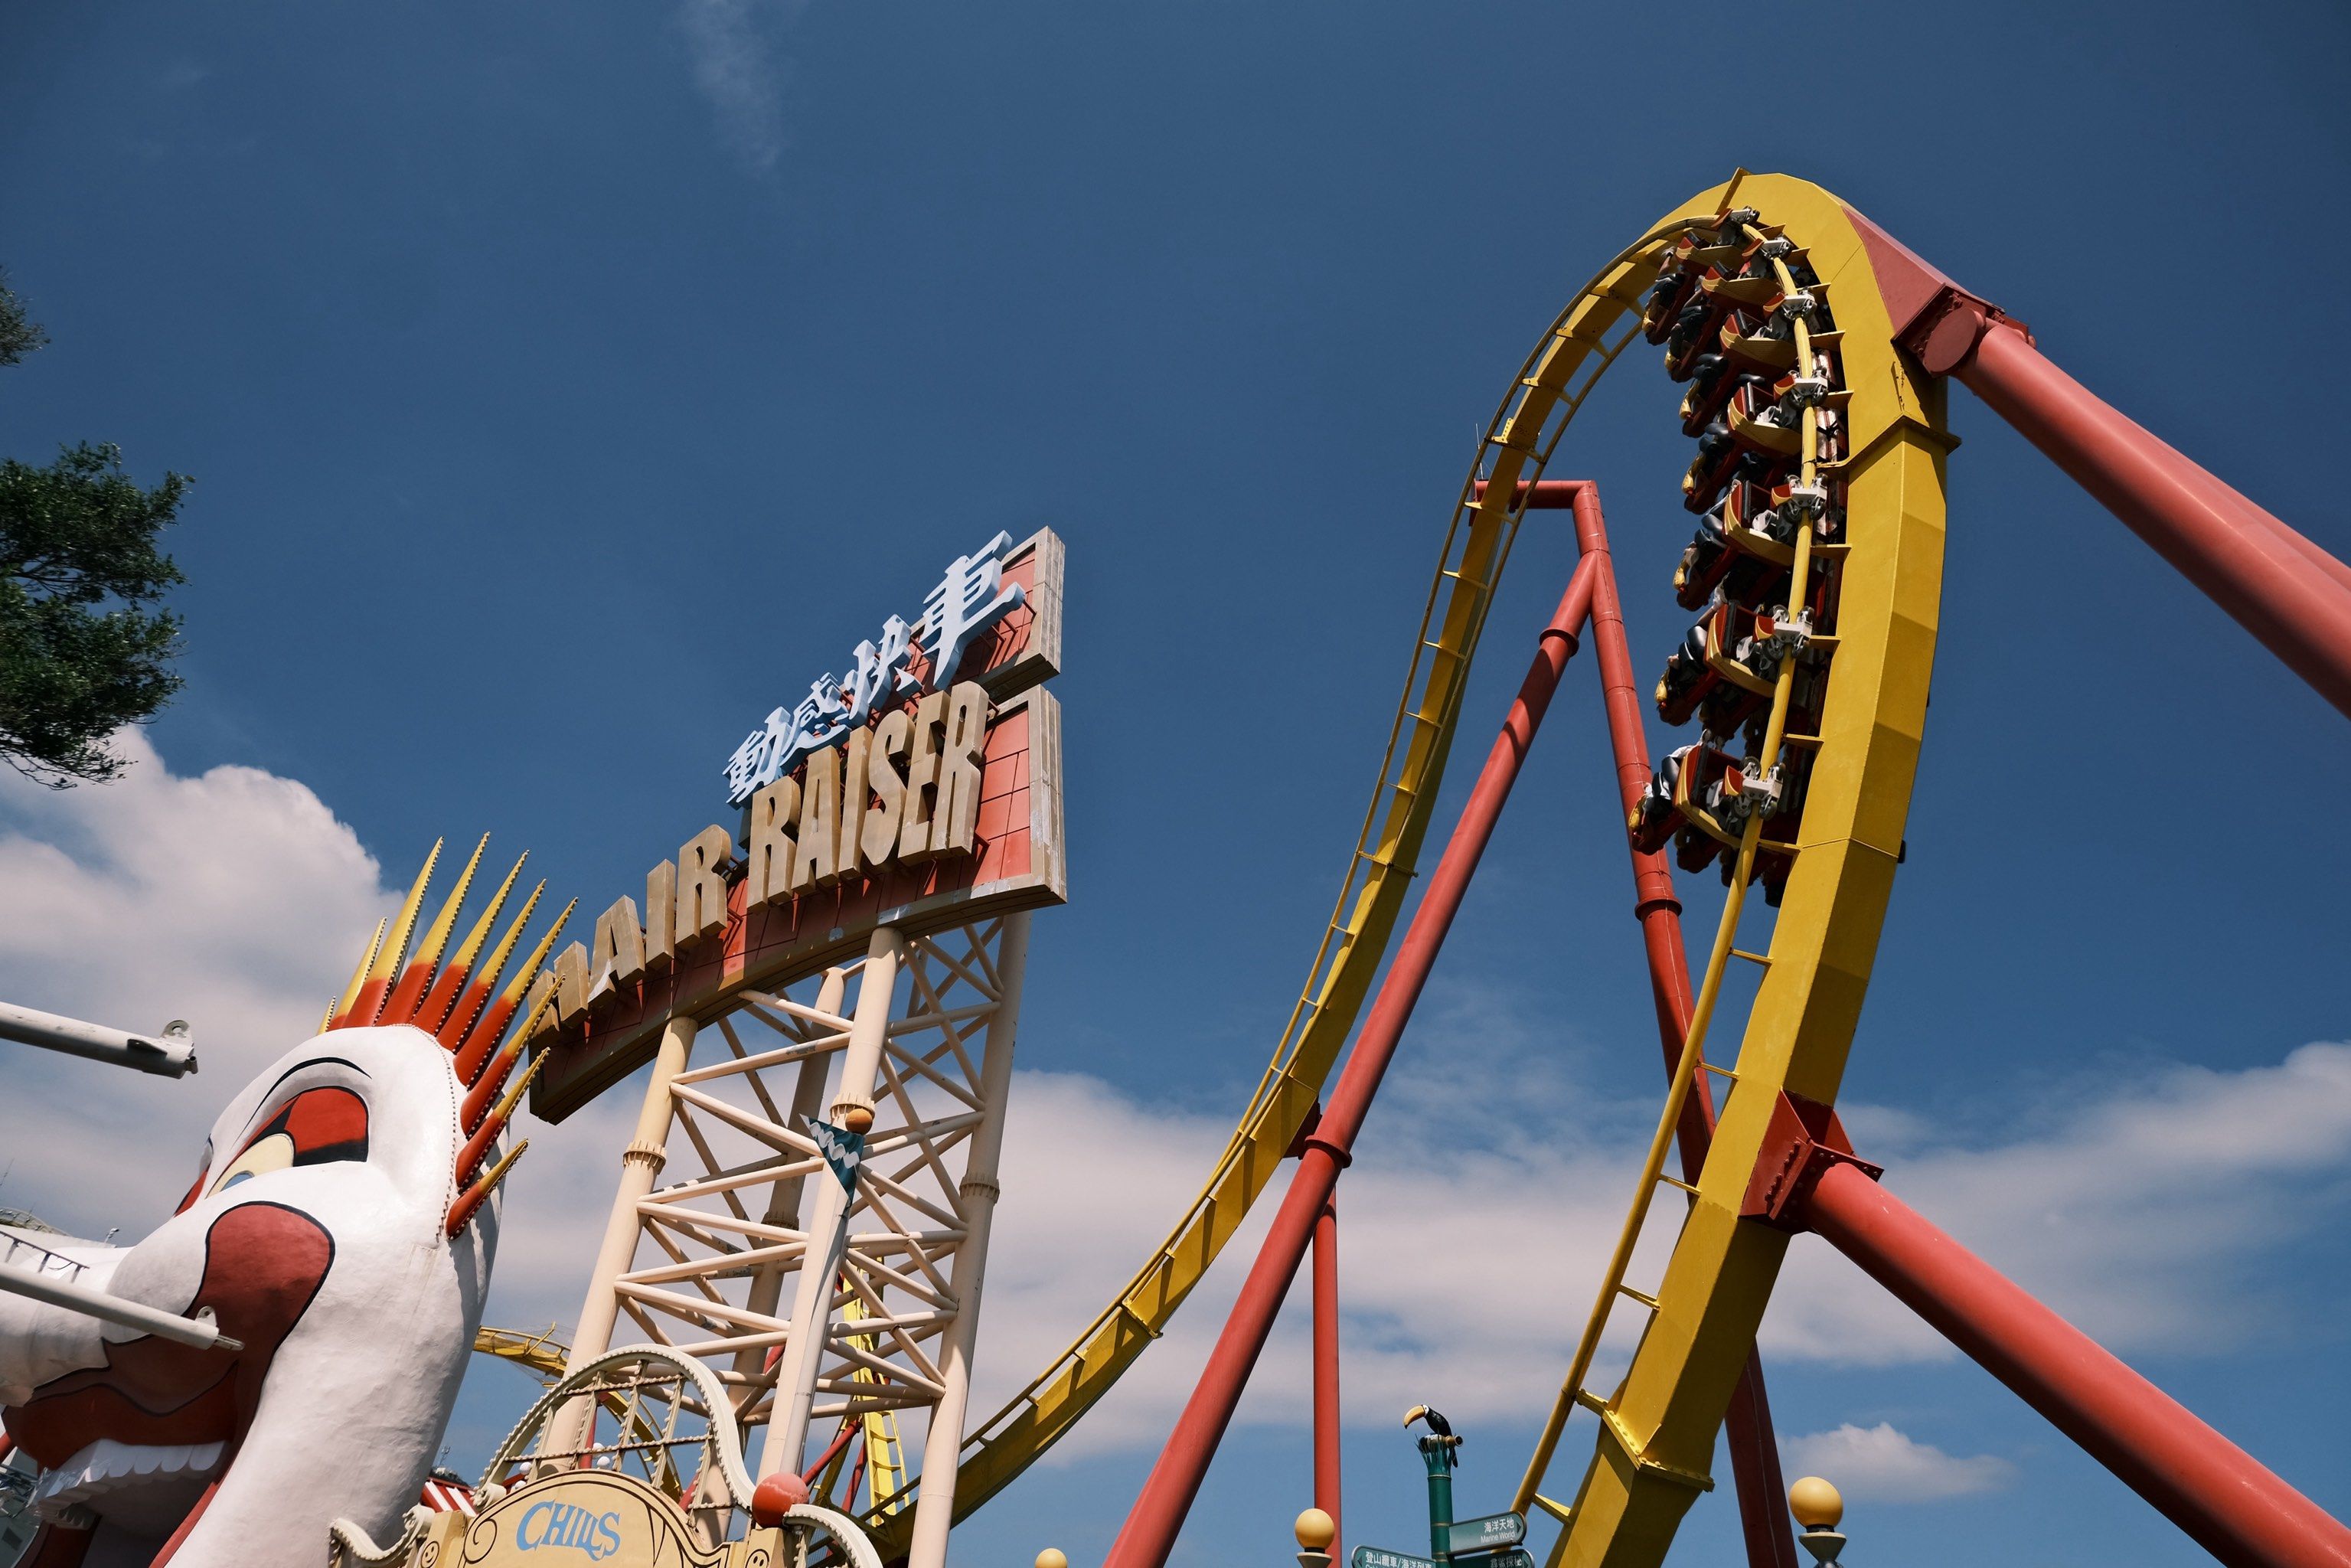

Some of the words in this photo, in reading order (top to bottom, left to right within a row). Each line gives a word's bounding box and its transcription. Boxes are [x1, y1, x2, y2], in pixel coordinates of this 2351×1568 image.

[723, 530, 1025, 810] 動感快車
[527, 824, 732, 1035] HAIR
[747, 681, 989, 912] RAISER
[516, 1498, 621, 1561] CHILLS
[1481, 1534, 1499, 1544] Marine
[1500, 1530, 1515, 1541] World
[1484, 1517, 1514, 1533] 海洋天地
